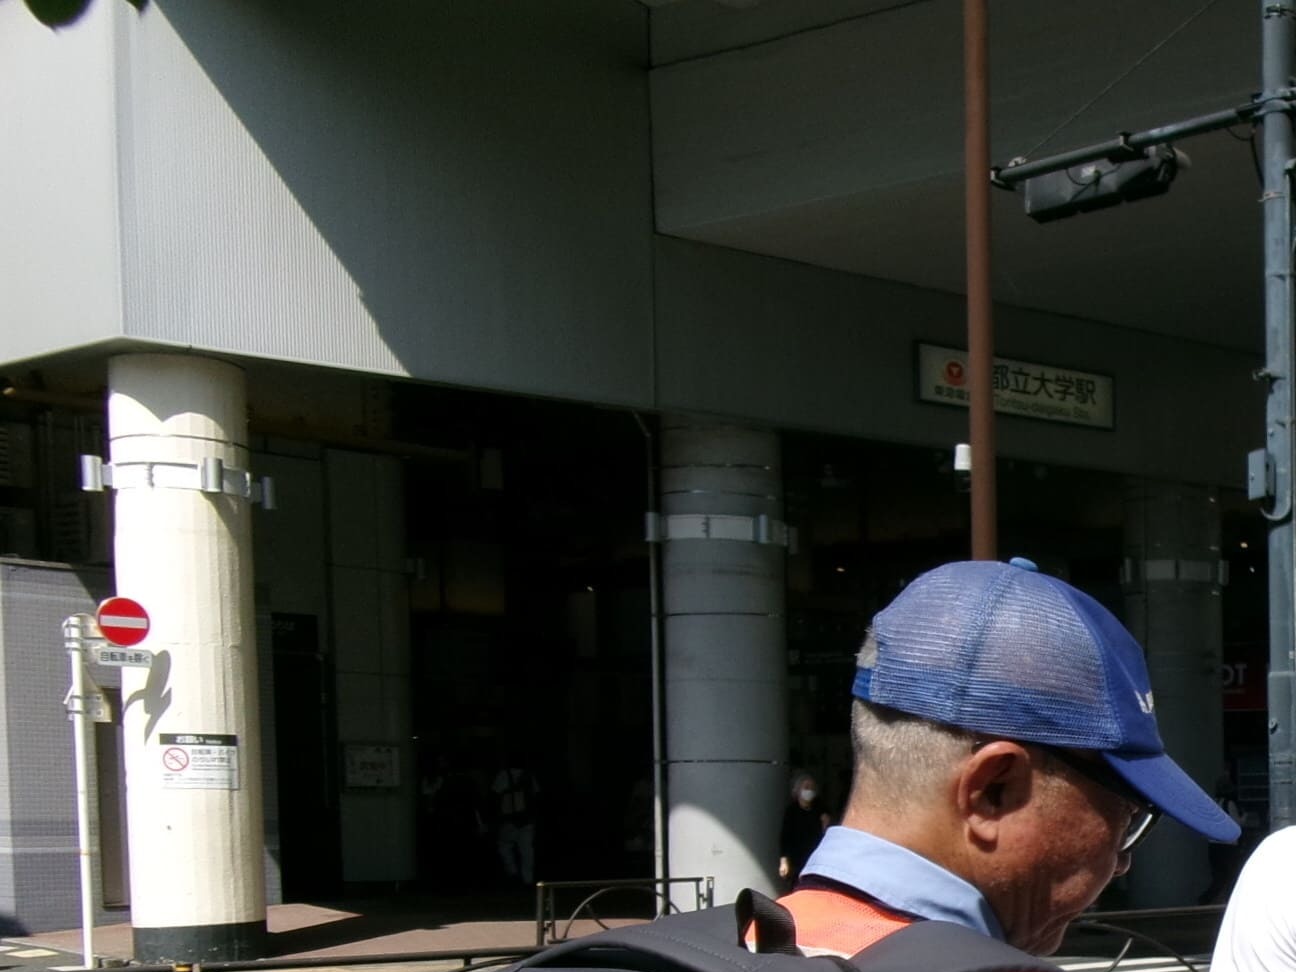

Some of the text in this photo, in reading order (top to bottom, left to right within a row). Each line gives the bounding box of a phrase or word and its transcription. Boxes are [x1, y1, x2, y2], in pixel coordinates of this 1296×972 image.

[993, 364, 1097, 406] 都立大学駅
